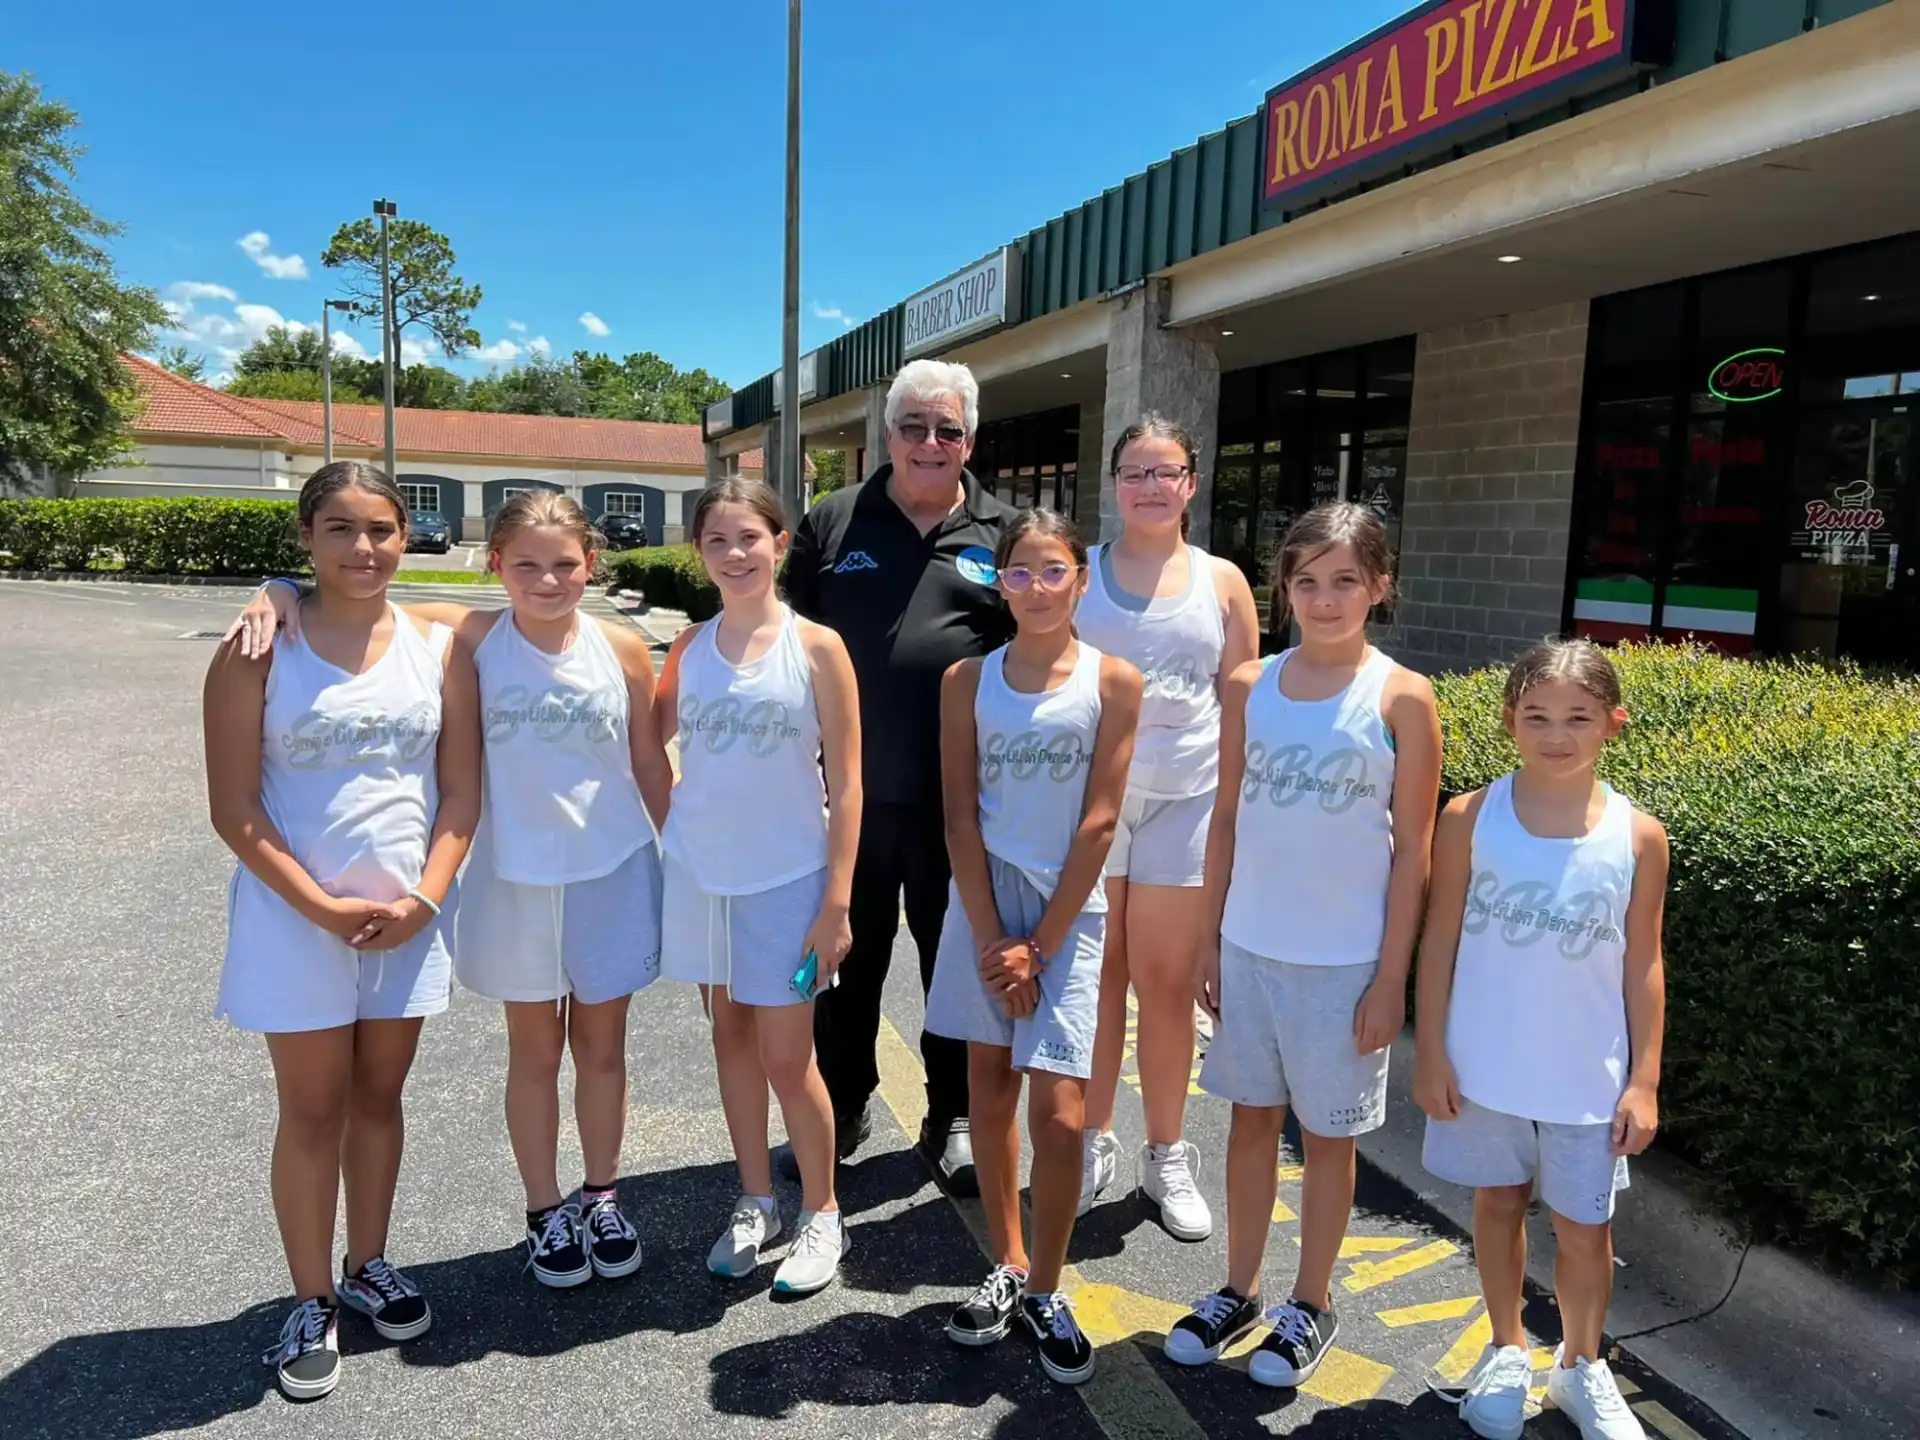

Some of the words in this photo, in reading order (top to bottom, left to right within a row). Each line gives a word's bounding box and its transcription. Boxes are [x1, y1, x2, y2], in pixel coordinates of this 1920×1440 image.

[1271, 44, 1408, 184] ROMA
[1418, 0, 1615, 122] PIZZA
[906, 289, 953, 345] BARBER
[955, 267, 996, 325] SHOP
[1720, 362, 1783, 388] OPEN
[1805, 500, 1885, 530] Roma
[1811, 531, 1869, 546] PIZZA
